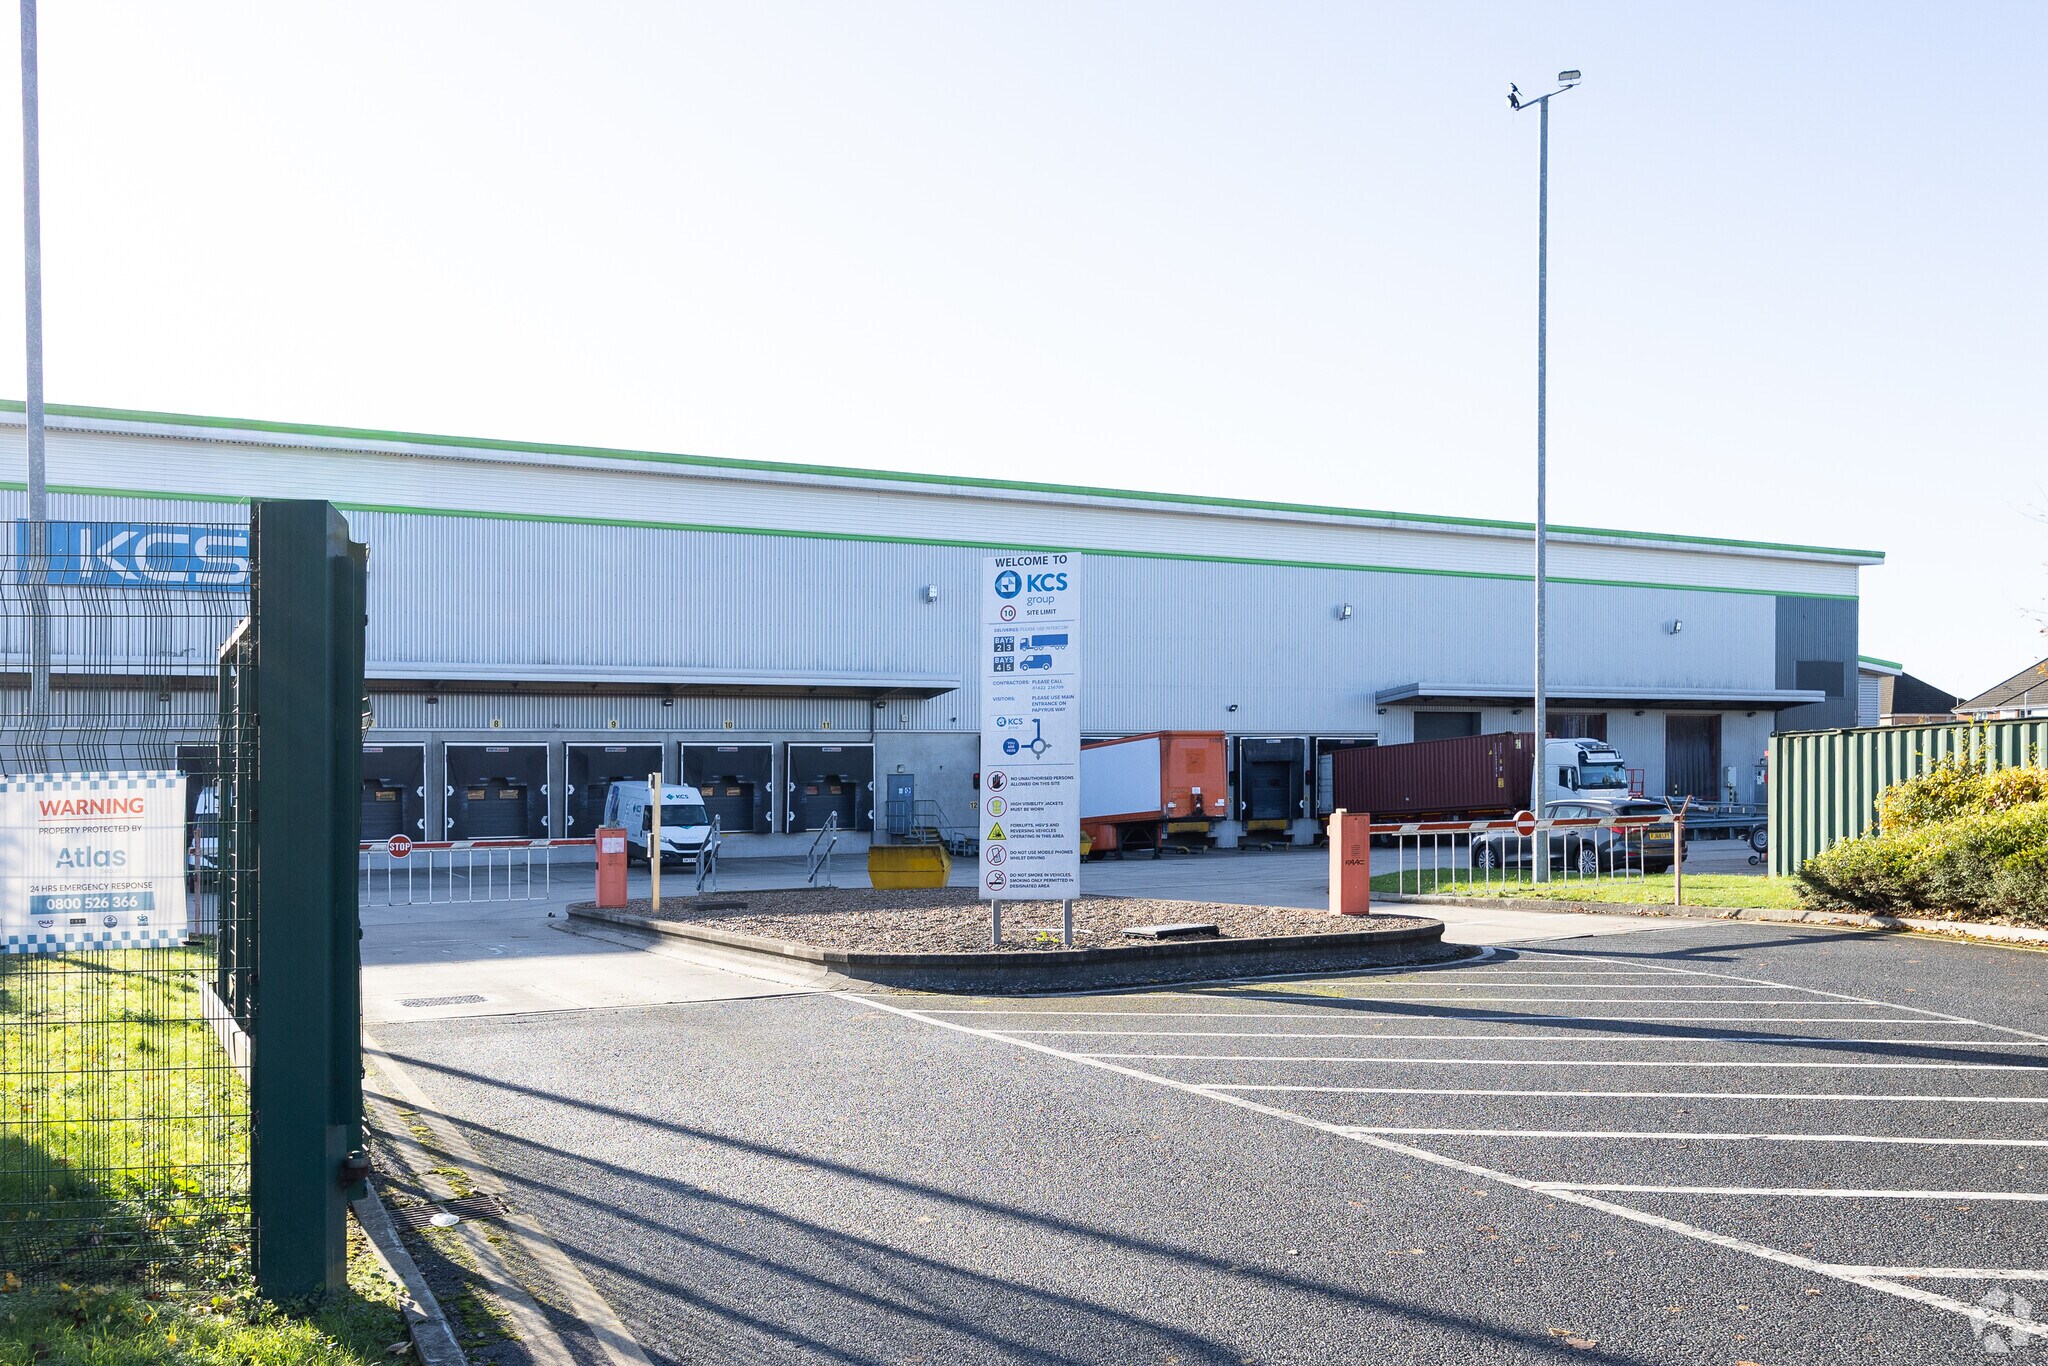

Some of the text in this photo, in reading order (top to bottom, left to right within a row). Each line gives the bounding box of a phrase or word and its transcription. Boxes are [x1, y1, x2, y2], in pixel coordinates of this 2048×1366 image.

[80, 527, 250, 584] KCS
[995, 555, 1067, 567] WELCOME TO
[1027, 573, 1068, 592] KCS
[1027, 596, 1054, 606] group
[1008, 718, 1023, 726] KCS
[39, 798, 144, 816] WARNING
[390, 842, 410, 851] STOP
[56, 846, 126, 868] Atlas
[60, 883, 109, 892] EMERGENCY
[111, 882, 153, 890] RESPONSE
[47, 896, 138, 910] 0800 526 366
